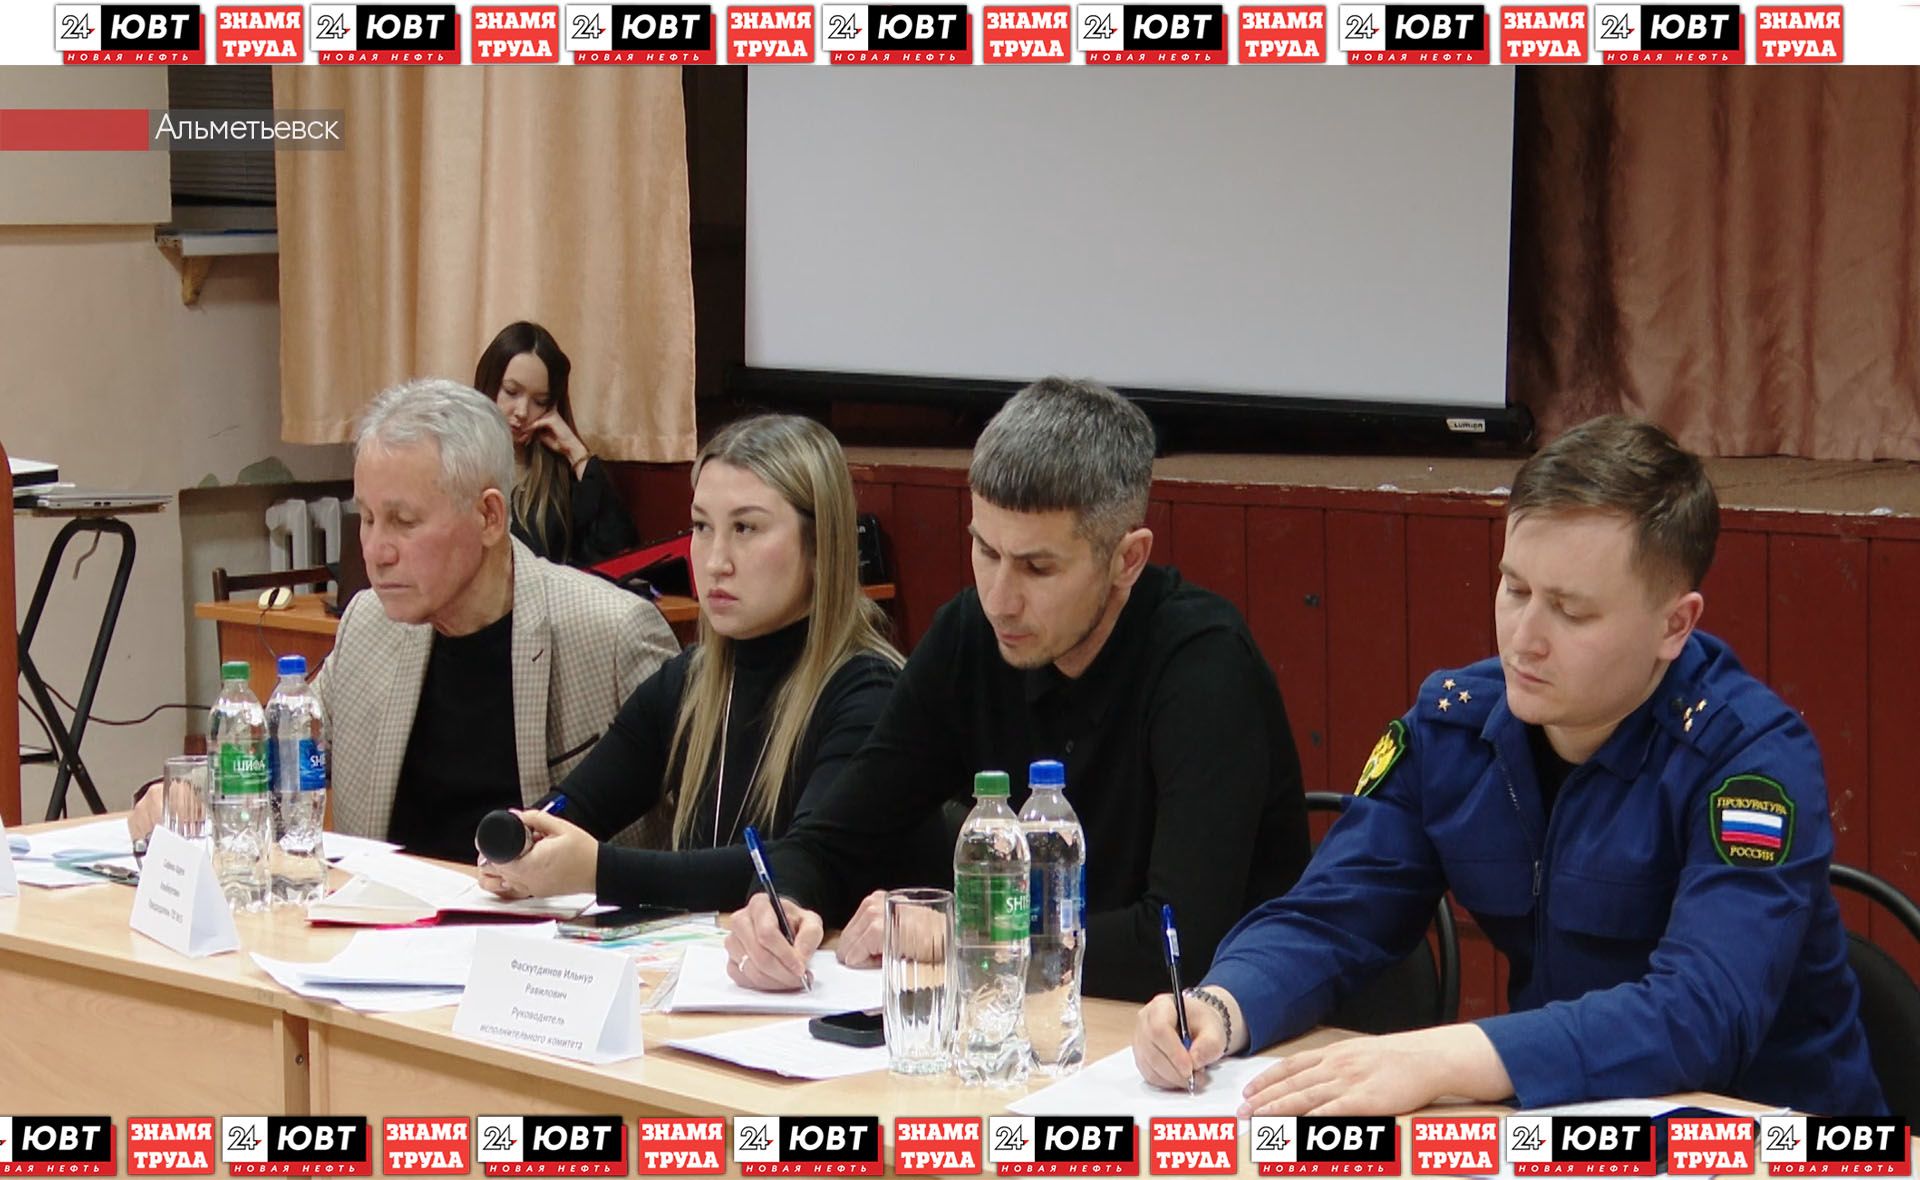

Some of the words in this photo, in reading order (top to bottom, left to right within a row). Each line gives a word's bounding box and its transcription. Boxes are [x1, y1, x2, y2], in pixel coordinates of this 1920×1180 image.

[1717, 796, 1787, 815] ПРОКУРАТУРА
[1729, 845, 1775, 861] РОССИИ
[563, 968, 594, 985] Ильнур
[525, 983, 568, 1000] Равилович
[511, 1006, 565, 1026] Руководитель
[480, 1024, 547, 1045] исполнительного
[547, 1034, 584, 1050] комитета
